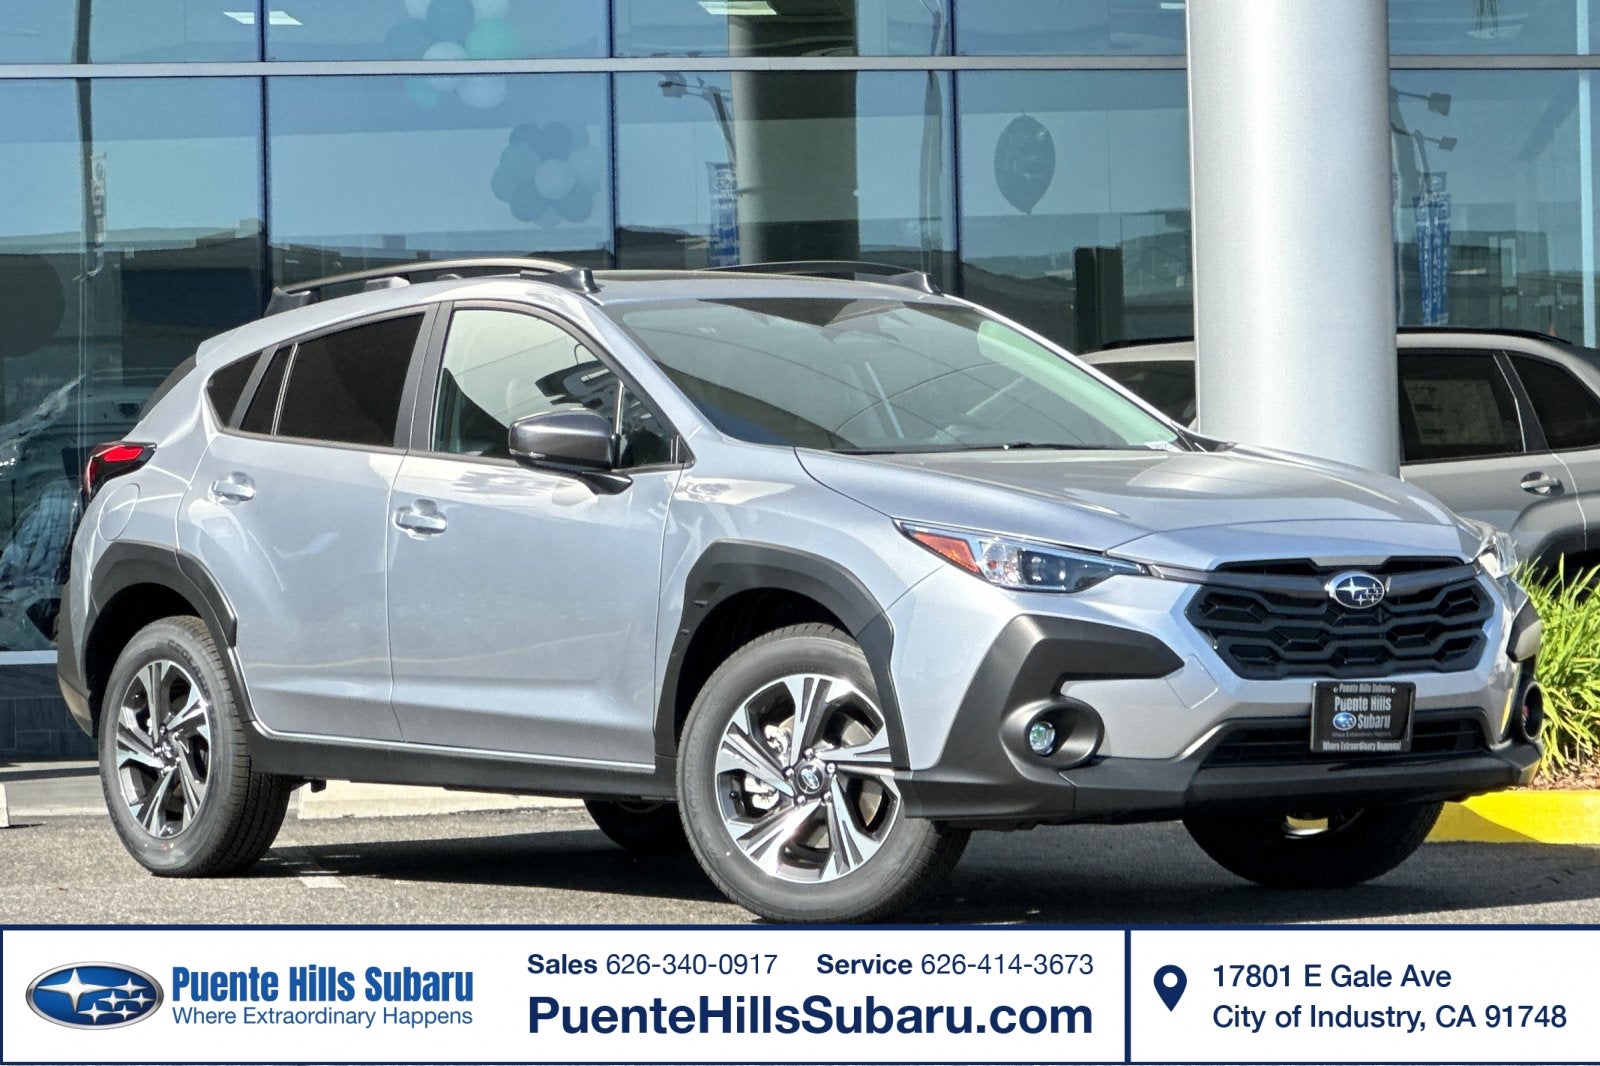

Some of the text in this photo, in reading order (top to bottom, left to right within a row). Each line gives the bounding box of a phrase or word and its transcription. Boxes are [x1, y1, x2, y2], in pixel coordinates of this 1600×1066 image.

[1339, 684, 1358, 693] Puente
[1360, 684, 1372, 693] Hills
[1334, 695, 1392, 711] Puente Hills
[1357, 714, 1391, 728] Subaru
[1323, 742, 1340, 750] Where
[1341, 742, 1376, 751] Extraordinary
